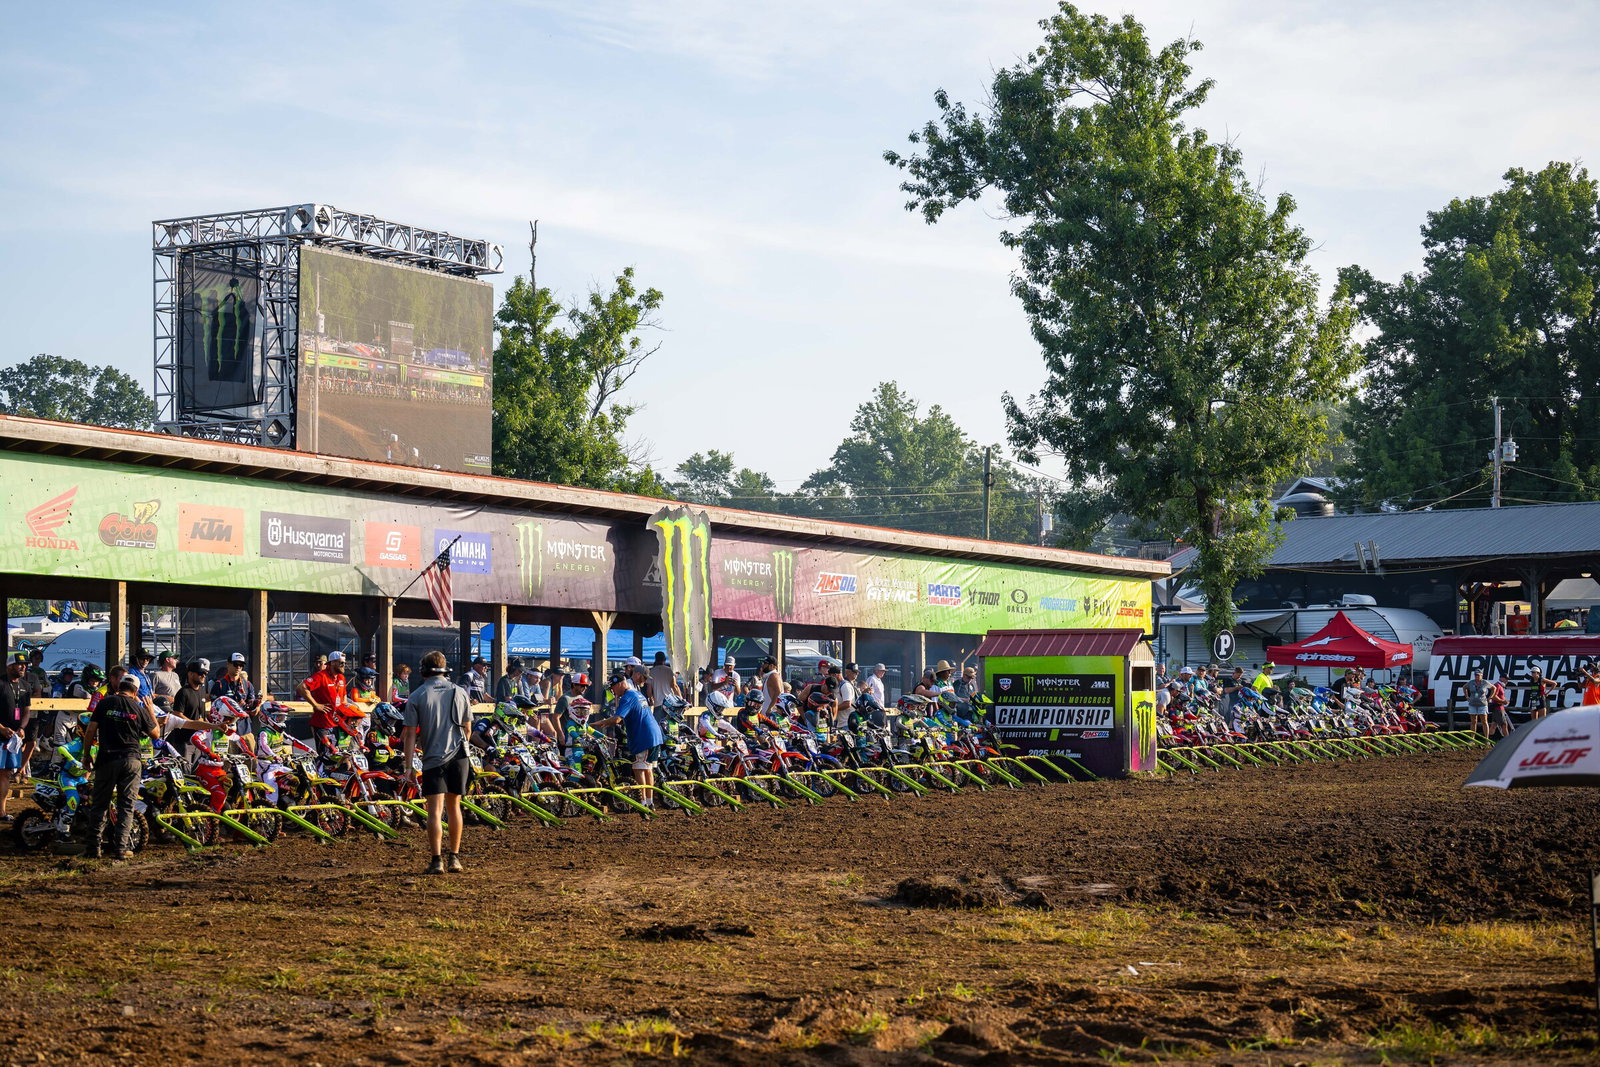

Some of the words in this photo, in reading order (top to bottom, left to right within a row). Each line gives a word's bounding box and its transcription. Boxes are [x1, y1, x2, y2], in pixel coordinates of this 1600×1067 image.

[190, 518, 233, 542] KTM
[283, 525, 344, 549] Husqvarna
[25, 536, 80, 551] HONDA
[115, 539, 156, 549] MOTO
[547, 538, 606, 561] MONSTER
[313, 550, 344, 559] MOTORCYCLES
[379, 552, 407, 561] GASGAS
[450, 541, 487, 560] YAMAHA
[556, 563, 597, 573] ENERGY
[724, 557, 772, 577] MONSTER
[731, 578, 765, 587] ENERGY
[814, 572, 856, 595] AMSOIL
[928, 584, 961, 598] PARTS
[978, 592, 1000, 606] THOR
[1007, 605, 1033, 614] OAKLEY
[1219, 632, 1231, 655] P
[1295, 652, 1357, 662] alpinestars
[1036, 678, 1081, 687] MONSTER
[998, 695, 1030, 703] AMATEUR
[1032, 696, 1066, 704] NATIONAL
[1069, 696, 1112, 704] MOTOCROSS
[998, 708, 1111, 725] CHAMPIONSHIP
[1081, 731, 1110, 739] AMSOIL
[1028, 749, 1049, 757] 2025
